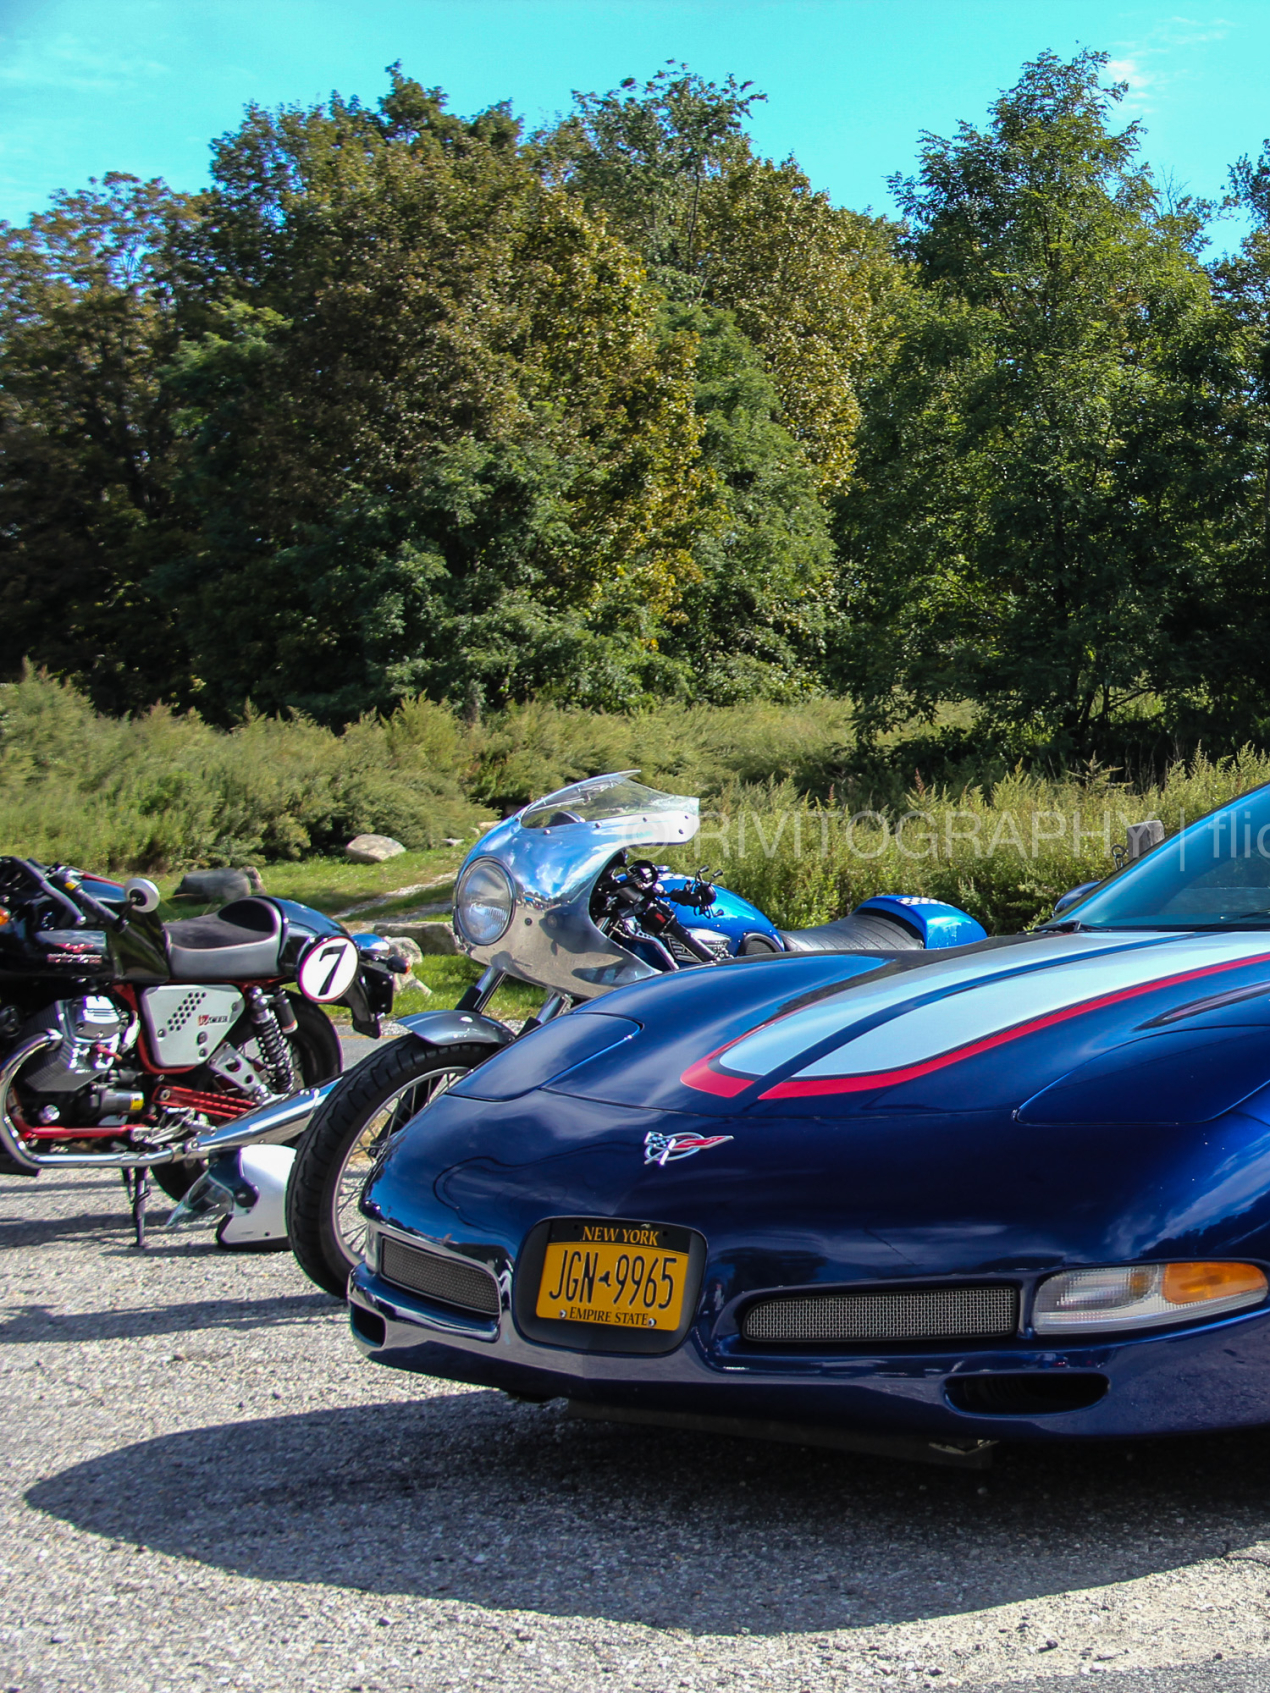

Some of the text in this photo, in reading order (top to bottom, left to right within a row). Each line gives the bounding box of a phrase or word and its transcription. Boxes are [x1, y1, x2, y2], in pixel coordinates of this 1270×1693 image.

[318, 943, 348, 997] 7
[582, 1226, 659, 1246] NEW YORK
[549, 1250, 677, 1309] JGN 9965
[569, 1306, 649, 1327] EMPIRE STATE
